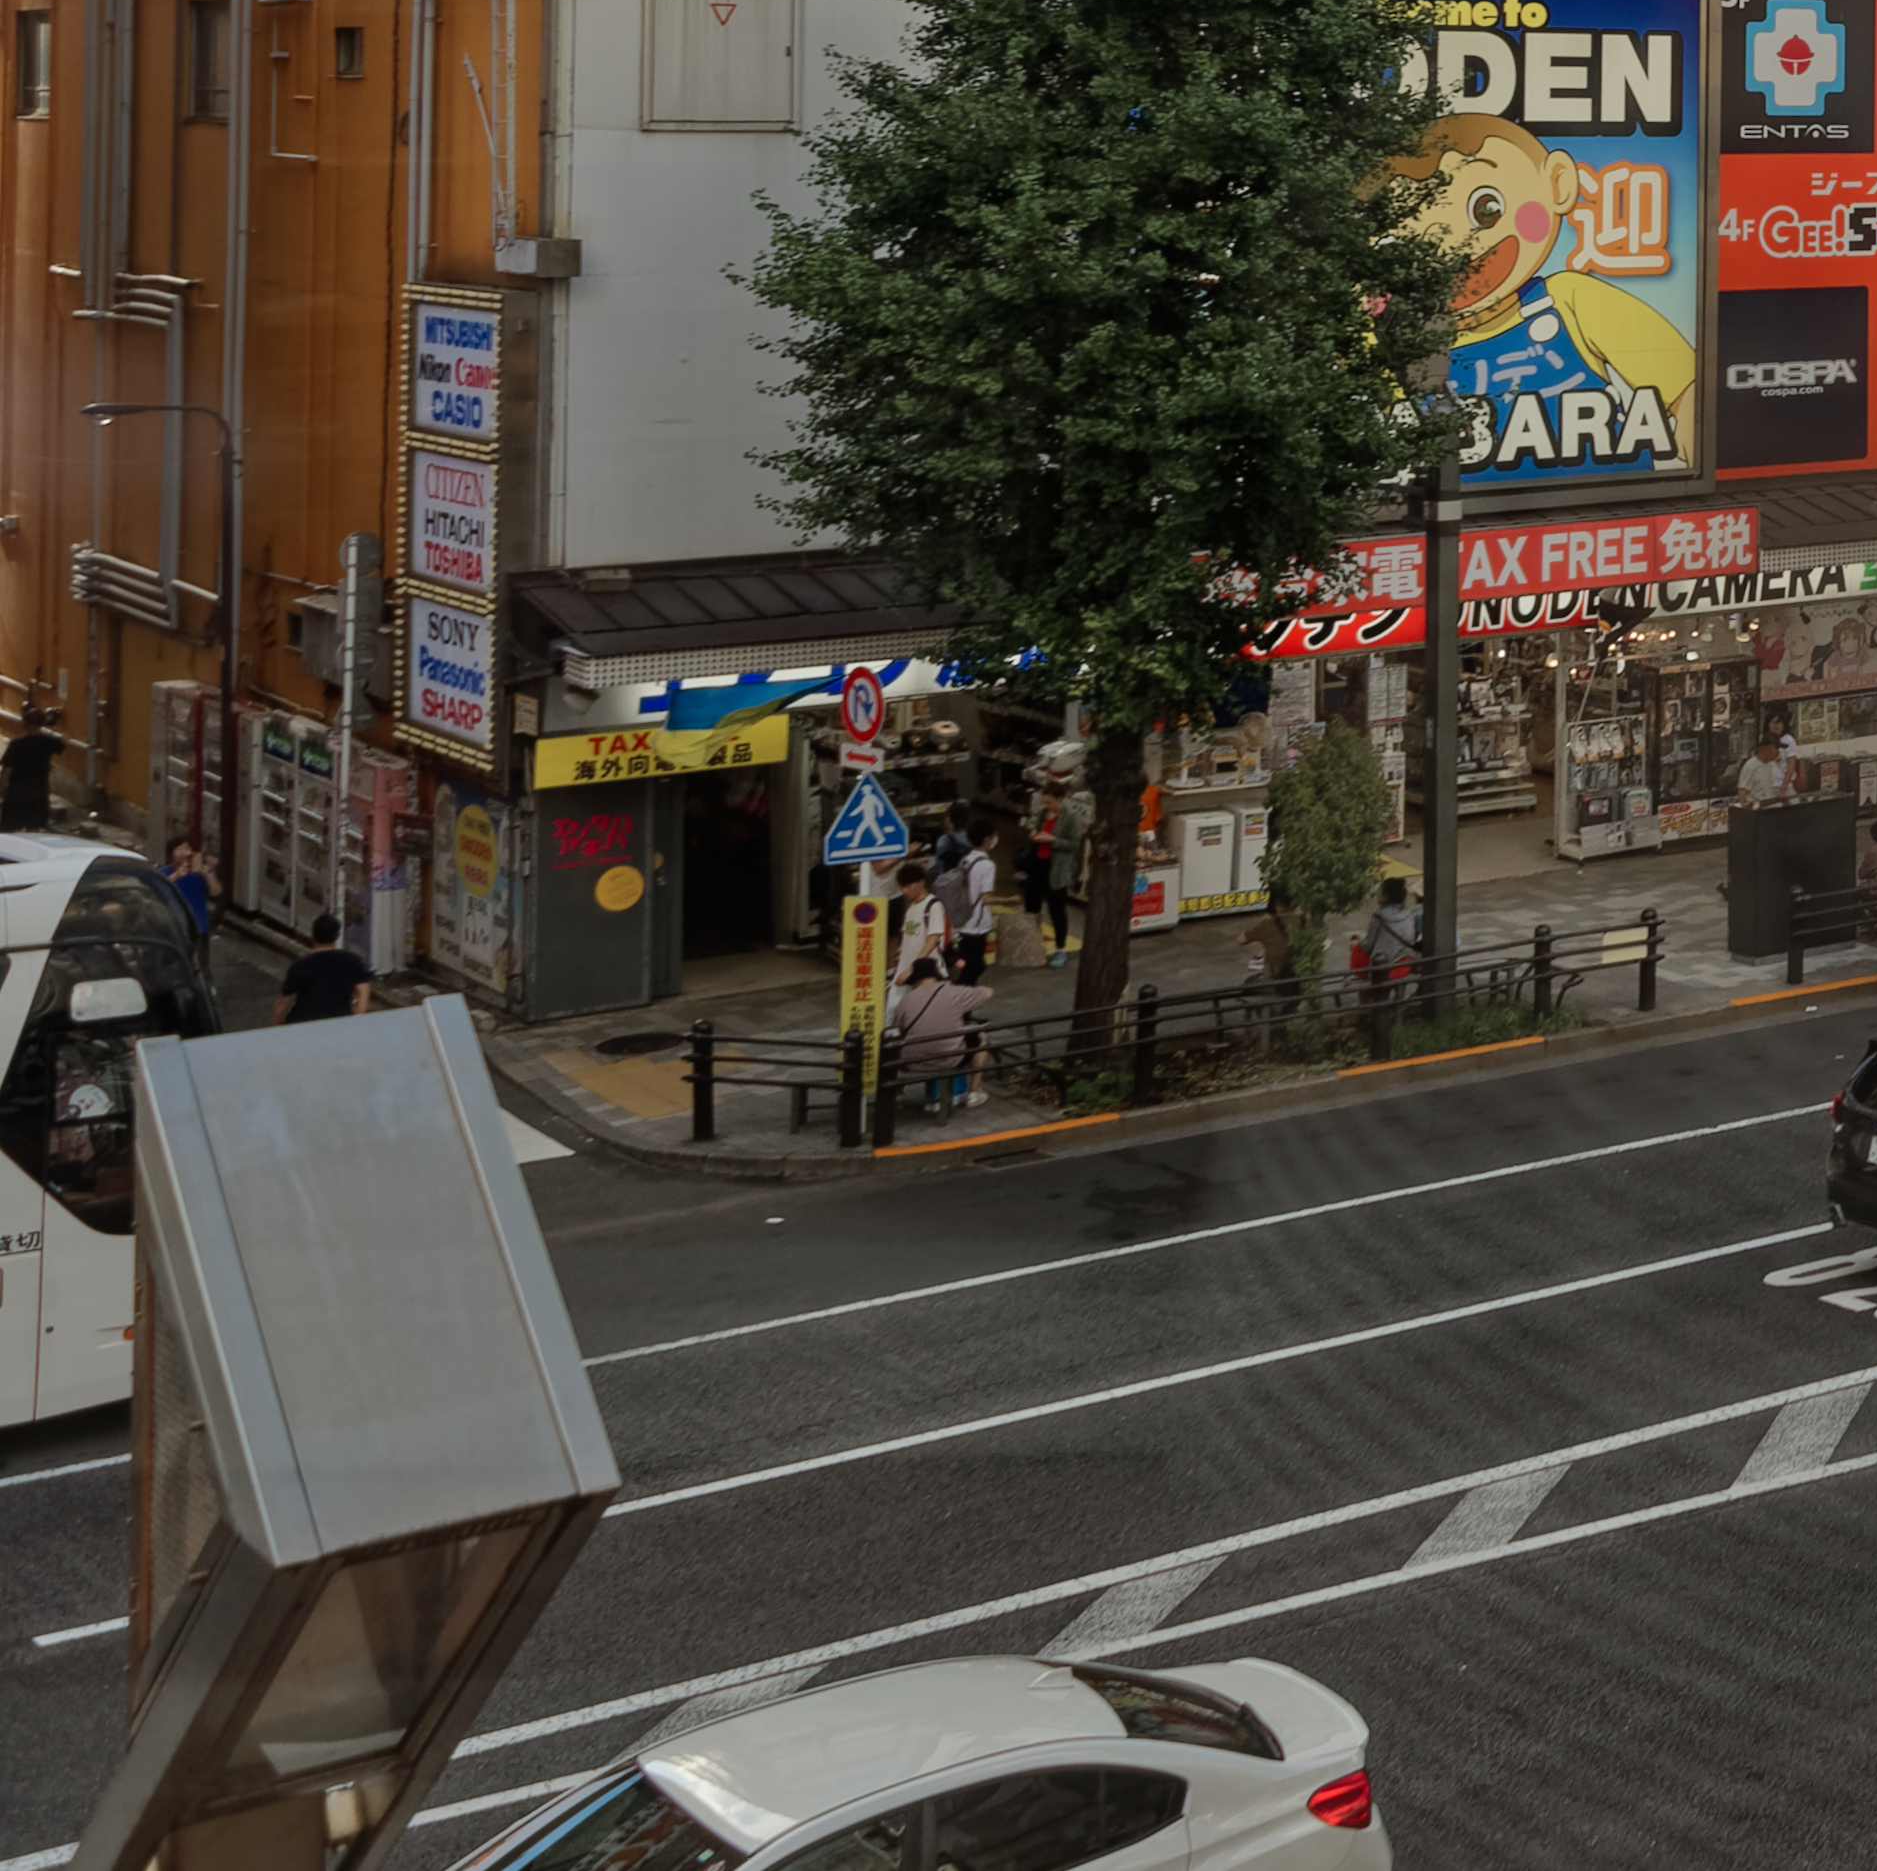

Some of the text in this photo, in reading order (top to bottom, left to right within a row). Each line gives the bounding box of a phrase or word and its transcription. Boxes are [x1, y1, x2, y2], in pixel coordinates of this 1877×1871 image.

[1739, 124, 1850, 140] ENTAS
[1718, 208, 1755, 242] 4F
[425, 315, 494, 353] MITSUBISHI
[418, 354, 451, 383] Nikon
[1727, 358, 1857, 390] COSPA
[431, 390, 484, 429] CASIO
[1761, 384, 1824, 397] cospa.com
[424, 462, 485, 509] CITIZEN
[425, 508, 485, 550] HITACHI
[1541, 512, 1753, 582] FREE 免税
[424, 540, 484, 584] TOSHIBA
[427, 612, 480, 652] SONY
[418, 645, 486, 698] Panasonic
[421, 688, 484, 732] SHARP
[588, 732, 651, 756] TAX
